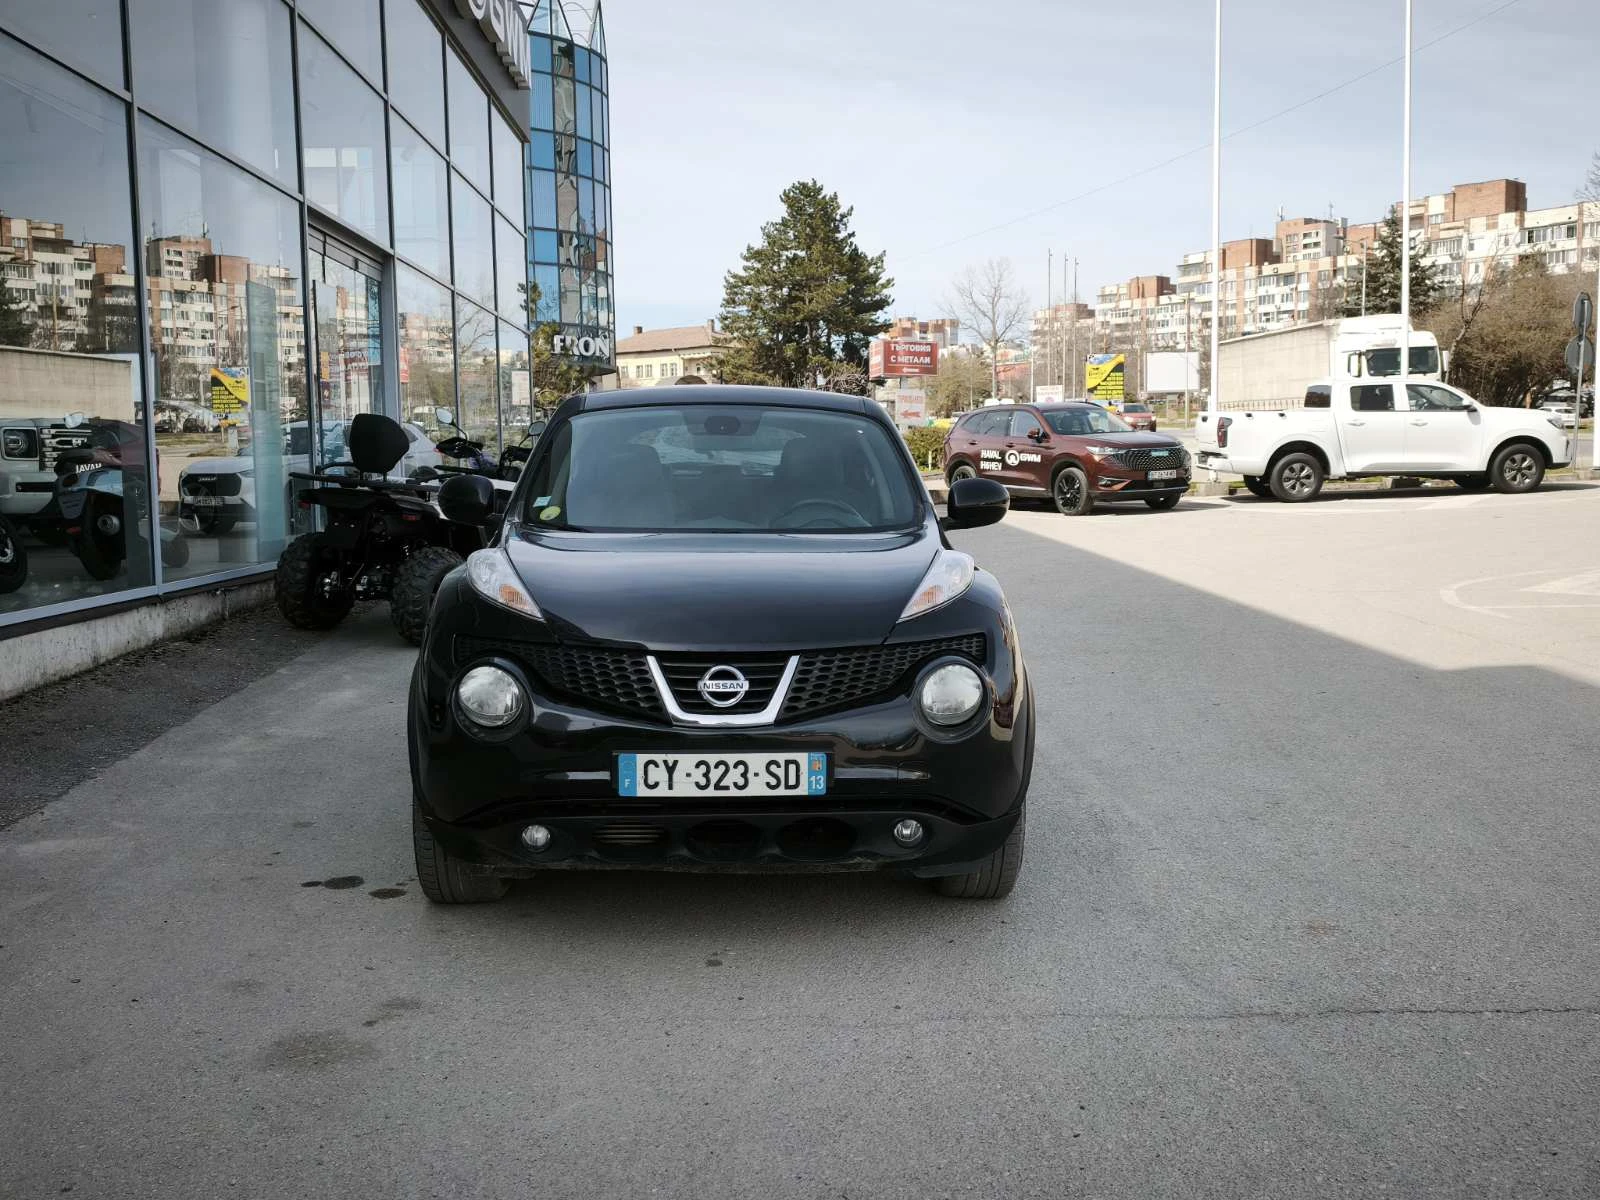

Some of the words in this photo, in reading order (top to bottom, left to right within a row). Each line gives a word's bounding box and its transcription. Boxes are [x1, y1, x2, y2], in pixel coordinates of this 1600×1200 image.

[890, 343, 931, 353] ТЪРГОВИЯ
[890, 355, 897, 363] С
[897, 355, 931, 364] МЕТАЛИ
[980, 449, 1002, 460] HAVAL
[1019, 453, 1042, 463] GWM
[703, 682, 744, 690] NISSAN
[624, 779, 632, 789] F
[810, 775, 824, 790] 13
